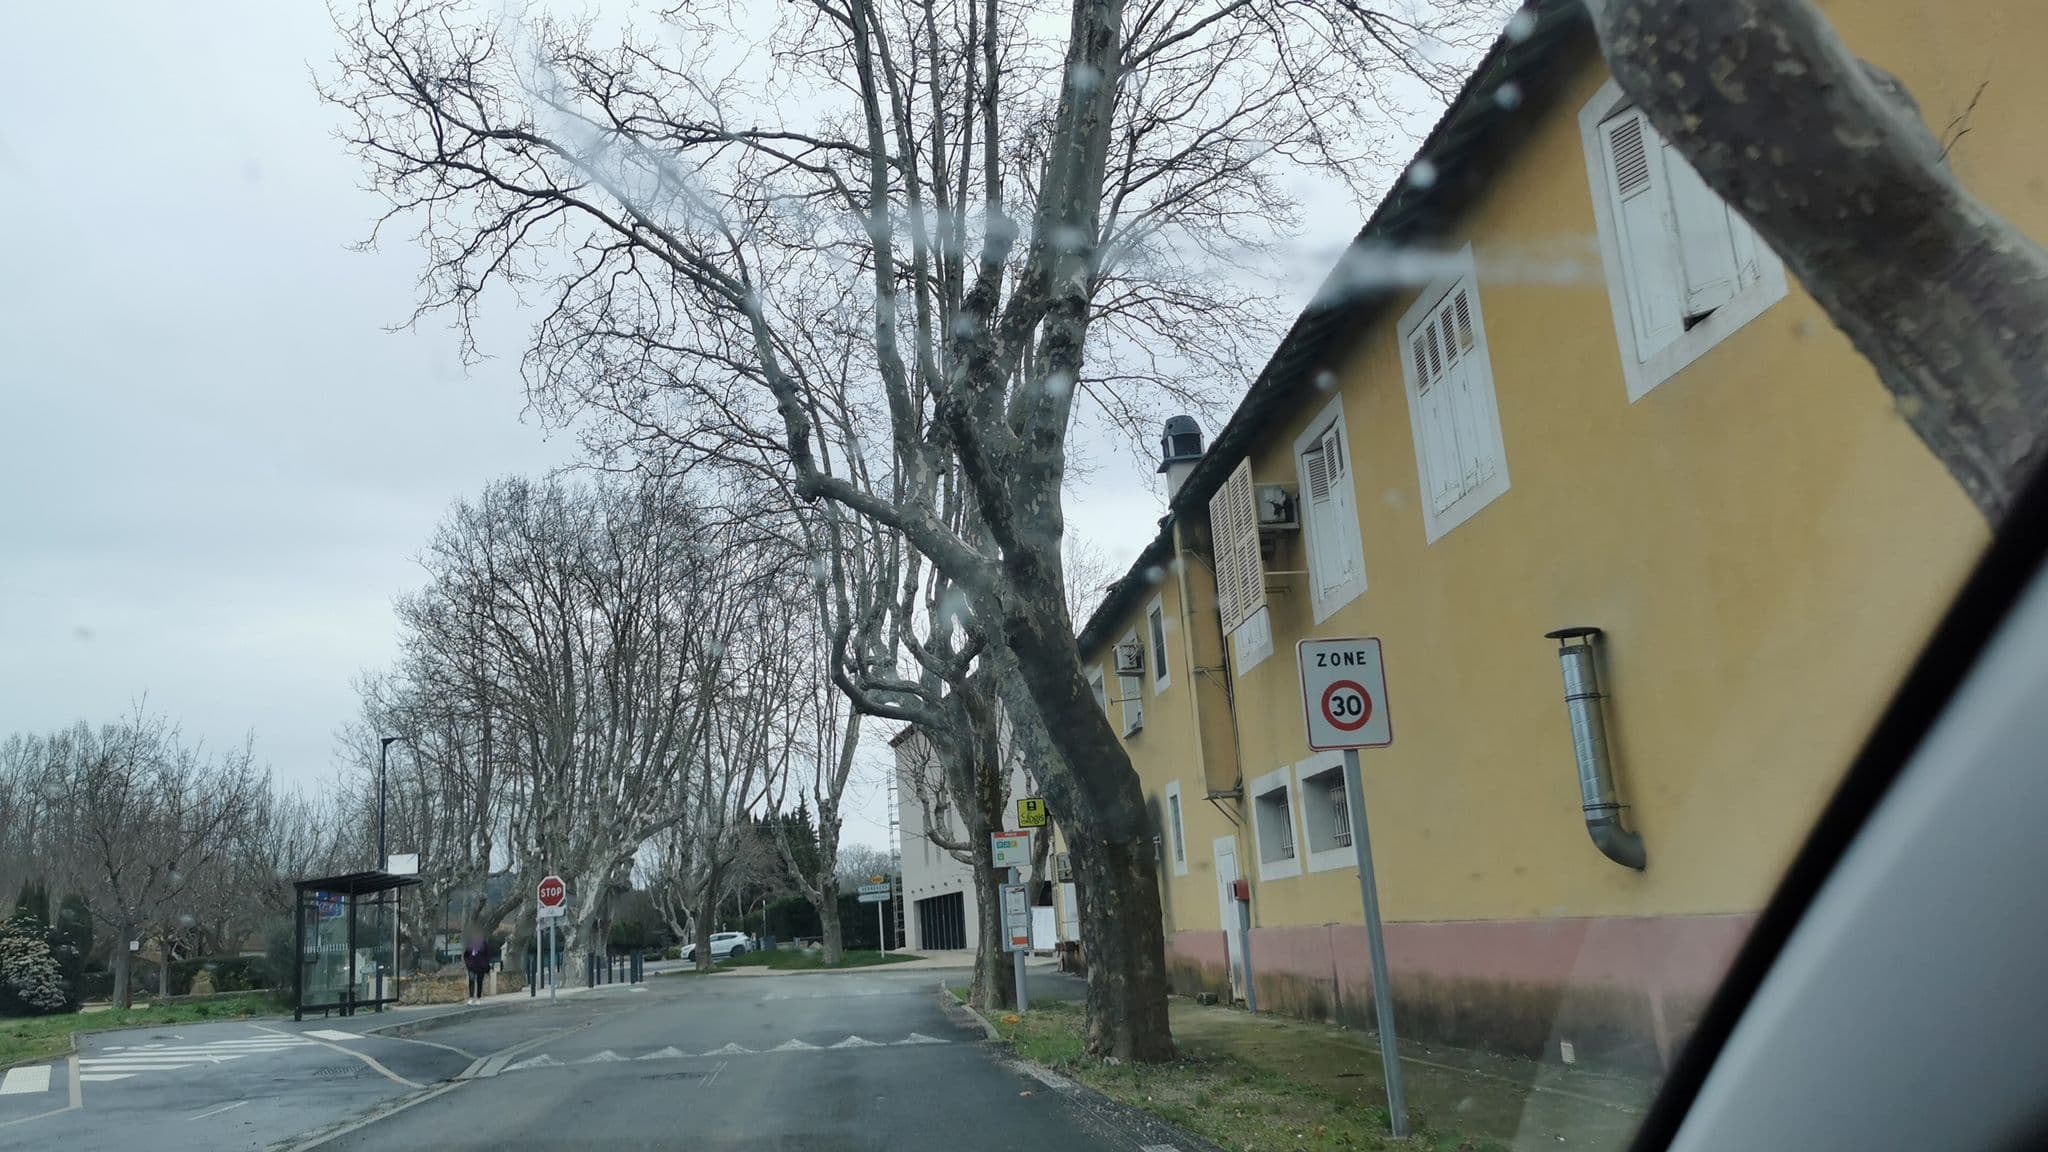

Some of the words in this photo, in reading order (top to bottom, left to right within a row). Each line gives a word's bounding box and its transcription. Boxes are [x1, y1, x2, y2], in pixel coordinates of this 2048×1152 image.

[1316, 651, 1366, 667] ZONE
[1332, 695, 1362, 716] 30
[540, 887, 562, 898] STOP
